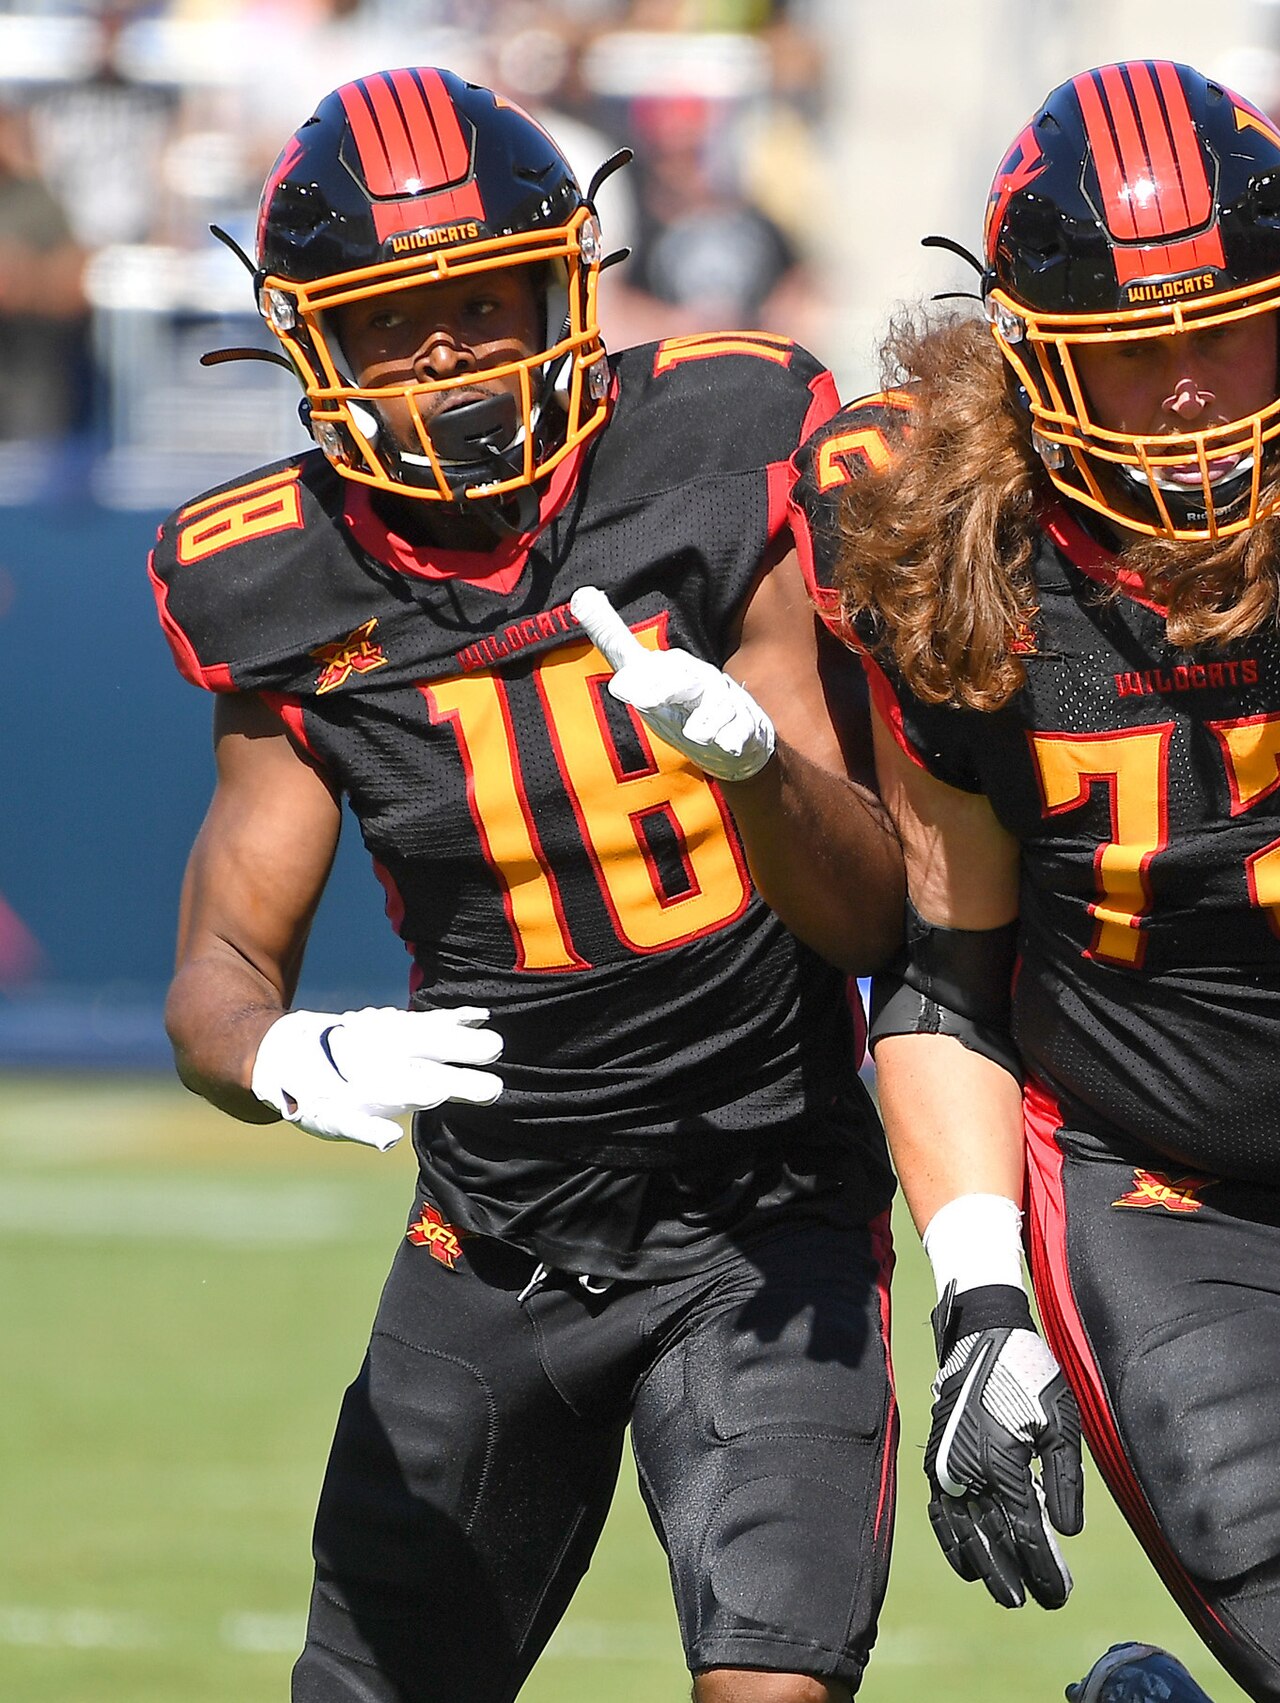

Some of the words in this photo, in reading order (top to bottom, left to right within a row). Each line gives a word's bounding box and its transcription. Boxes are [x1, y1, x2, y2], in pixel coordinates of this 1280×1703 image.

[392, 222, 478, 253] WILDCATS
[1127, 273, 1215, 303] WILDCATS
[176, 460, 306, 568] 18
[1114, 659, 1259, 698] WILDCATS
[408, 1209, 464, 1260] XFL
